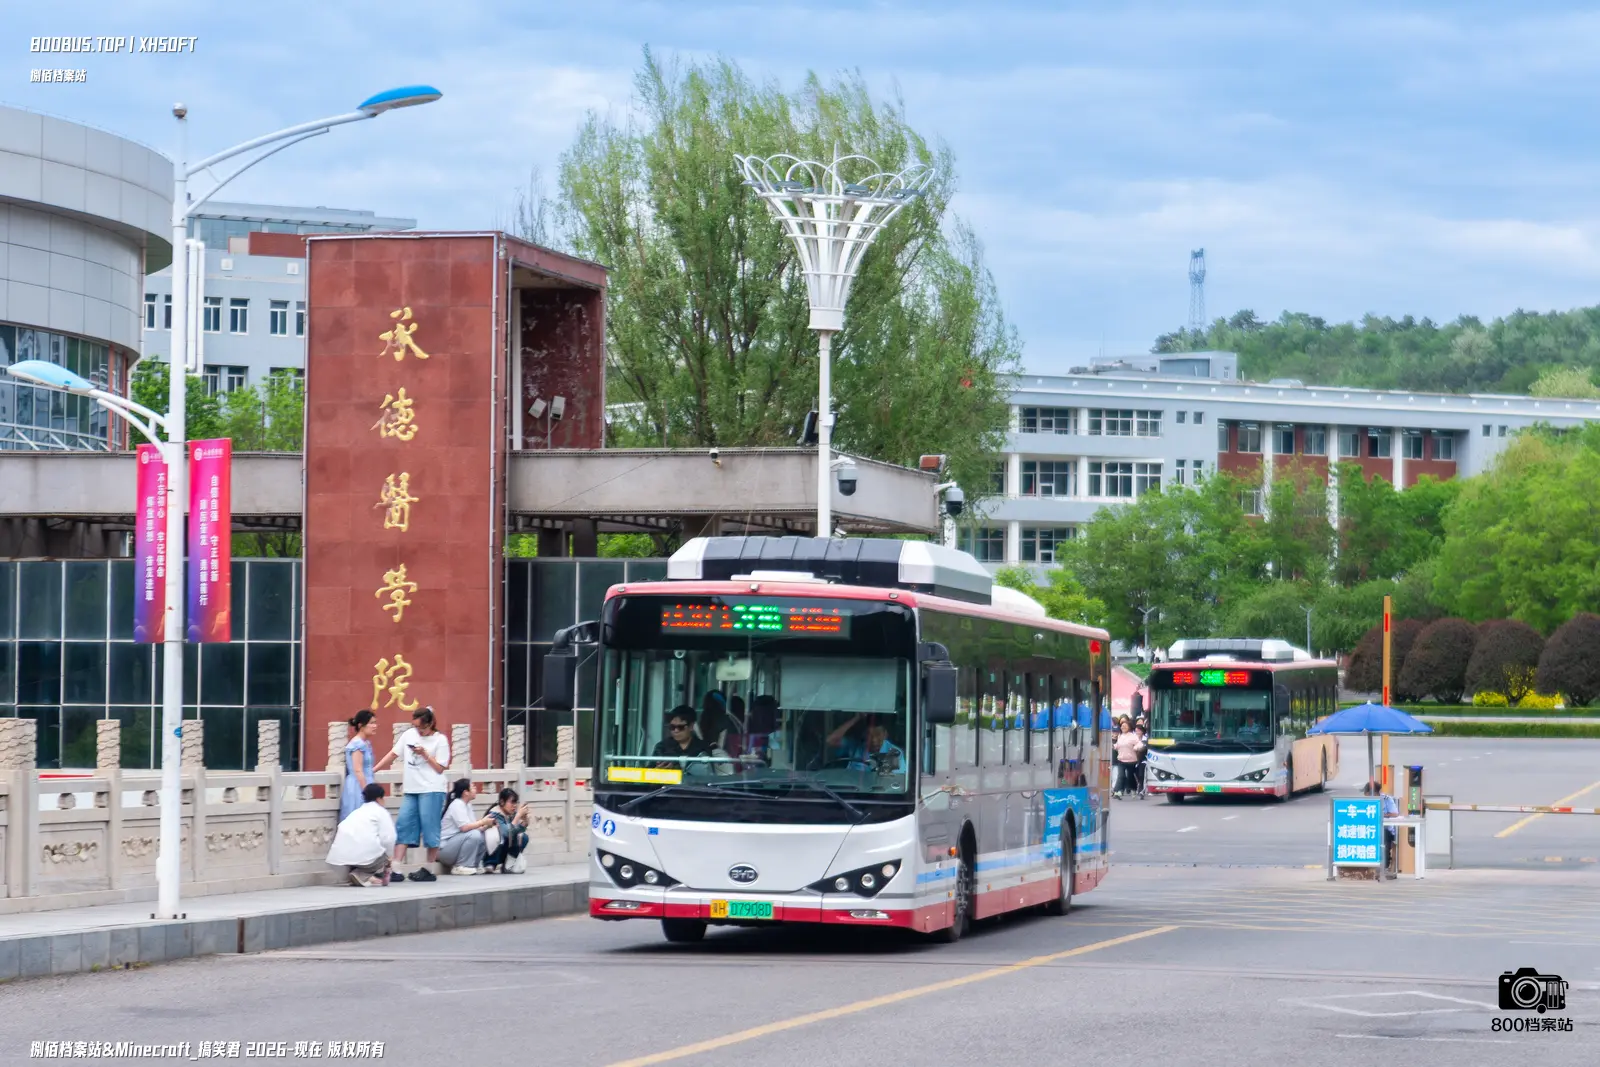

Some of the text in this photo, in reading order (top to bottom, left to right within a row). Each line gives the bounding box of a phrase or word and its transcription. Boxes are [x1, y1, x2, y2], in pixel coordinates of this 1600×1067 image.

[156, 473, 166, 577] 不忘初心 牢记使命
[1337, 804, 1377, 818] 一车一杆
[1337, 825, 1377, 839] 减速慢行
[1337, 844, 1377, 859] 损坏赔偿
[731, 869, 755, 879] BYD
